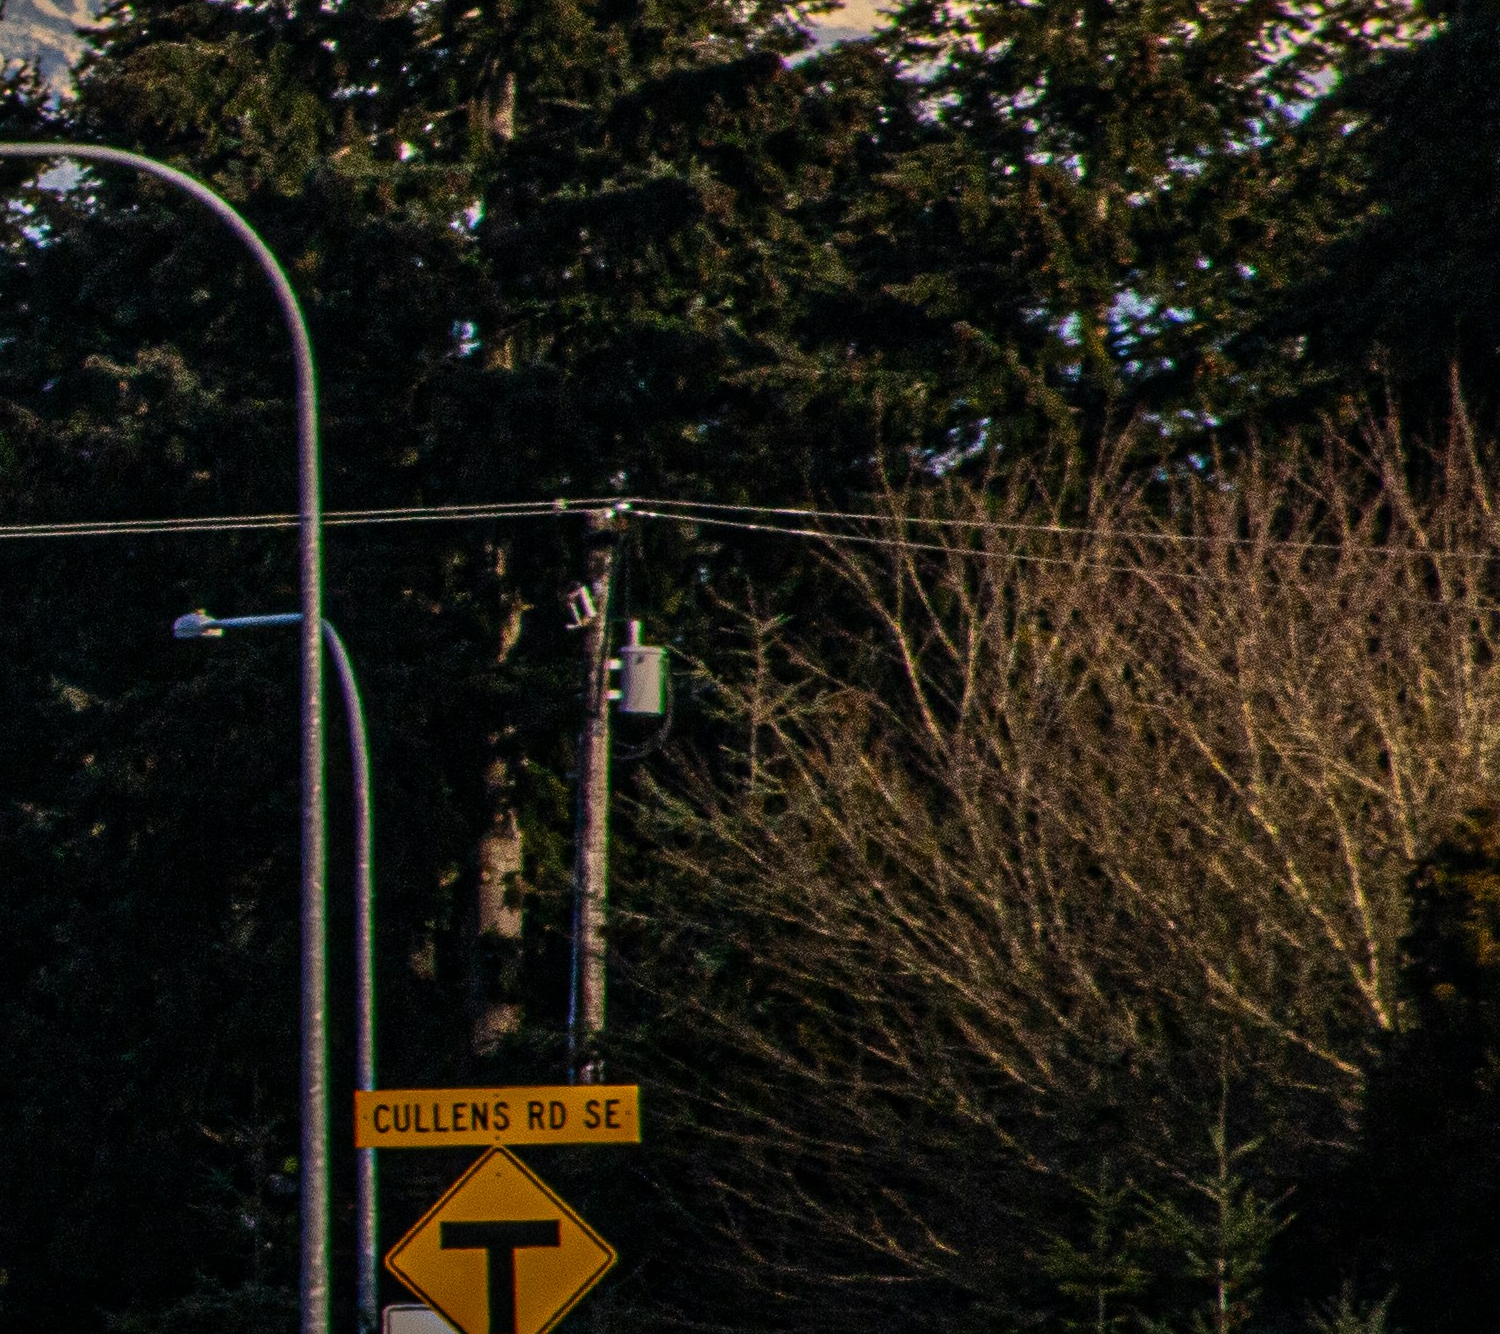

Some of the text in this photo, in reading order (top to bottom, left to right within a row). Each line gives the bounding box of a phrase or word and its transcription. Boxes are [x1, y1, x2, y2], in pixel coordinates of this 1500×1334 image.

[373, 1099, 621, 1133] CULLENS RD SE
